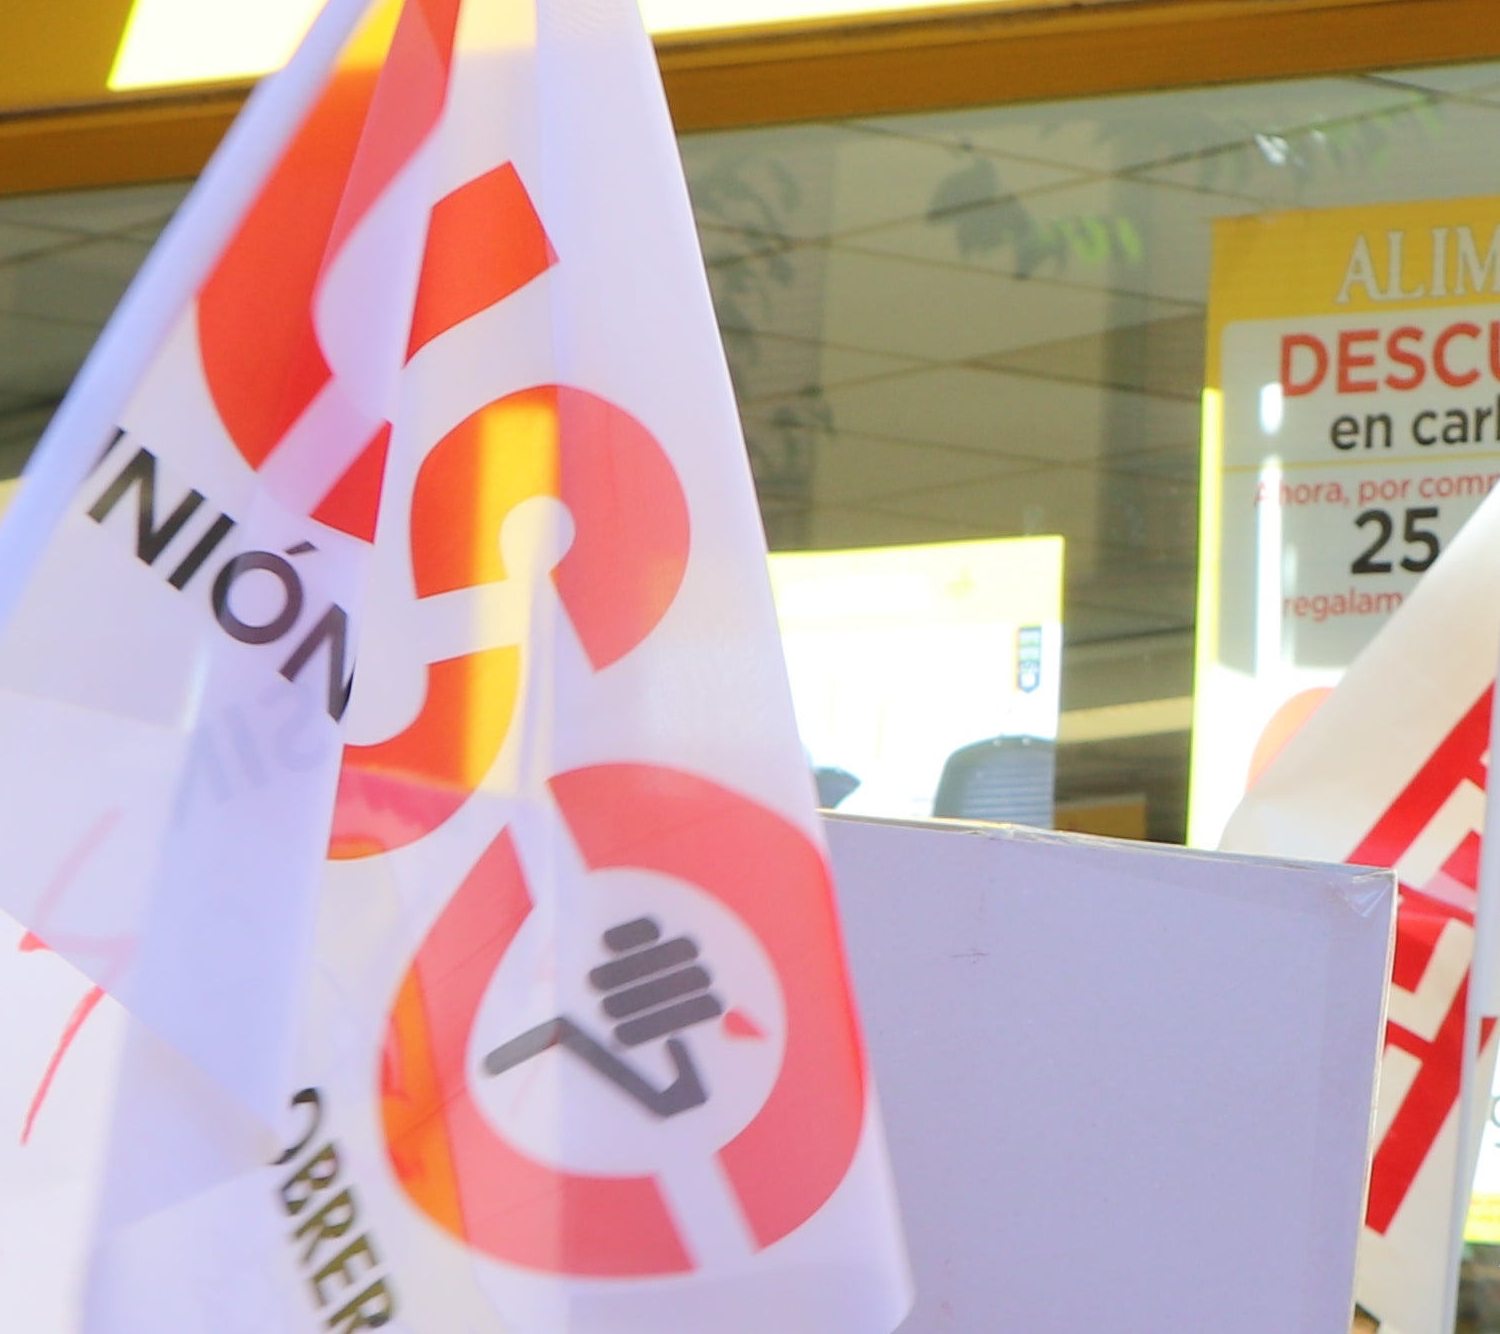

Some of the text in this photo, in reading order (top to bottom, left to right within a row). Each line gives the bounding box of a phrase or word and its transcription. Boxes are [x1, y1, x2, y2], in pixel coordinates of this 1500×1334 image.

[1330, 412, 1393, 452] en
[1358, 479, 1414, 510] por
[1349, 506, 1442, 575] 25
[83, 427, 357, 724] NIÓN
